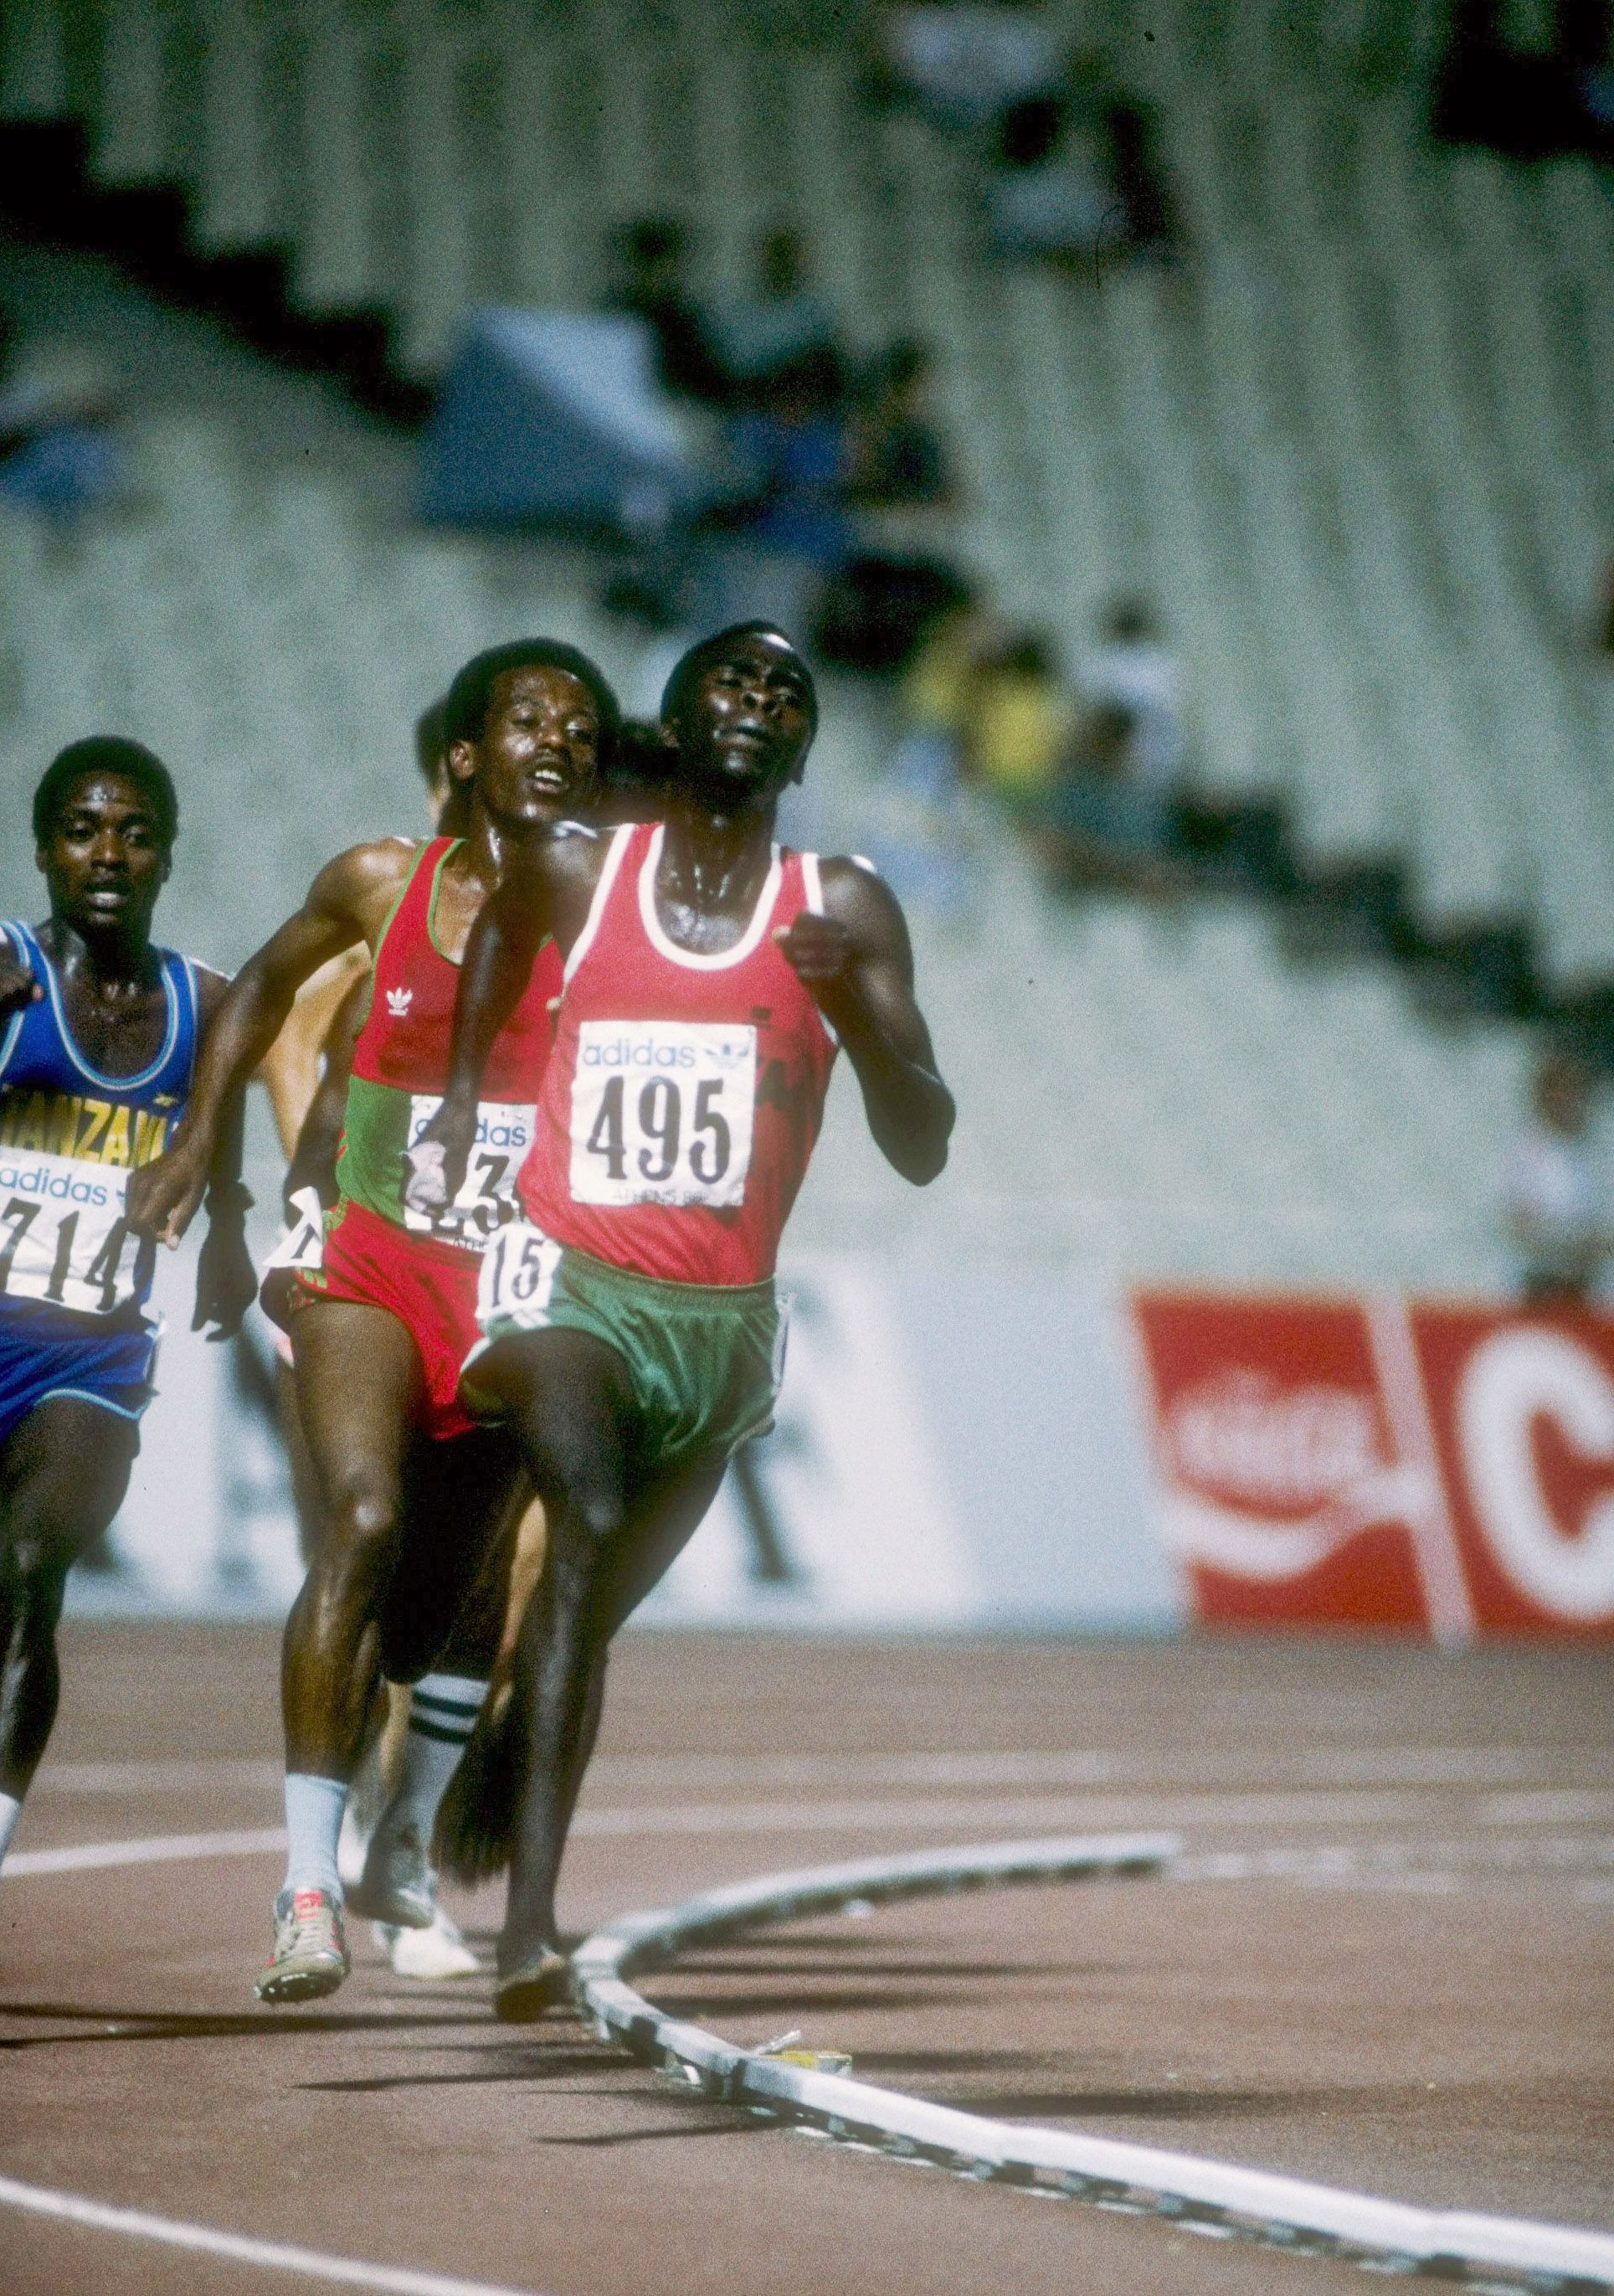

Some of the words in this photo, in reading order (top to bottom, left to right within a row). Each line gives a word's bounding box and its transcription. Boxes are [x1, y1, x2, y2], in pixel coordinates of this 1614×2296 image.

[583, 1038, 696, 1068] adidas
[587, 1075, 730, 1184] 495
[0, 1166, 107, 1205] adidas
[0, 1197, 126, 1310] 714
[491, 1235, 544, 1307] 15
